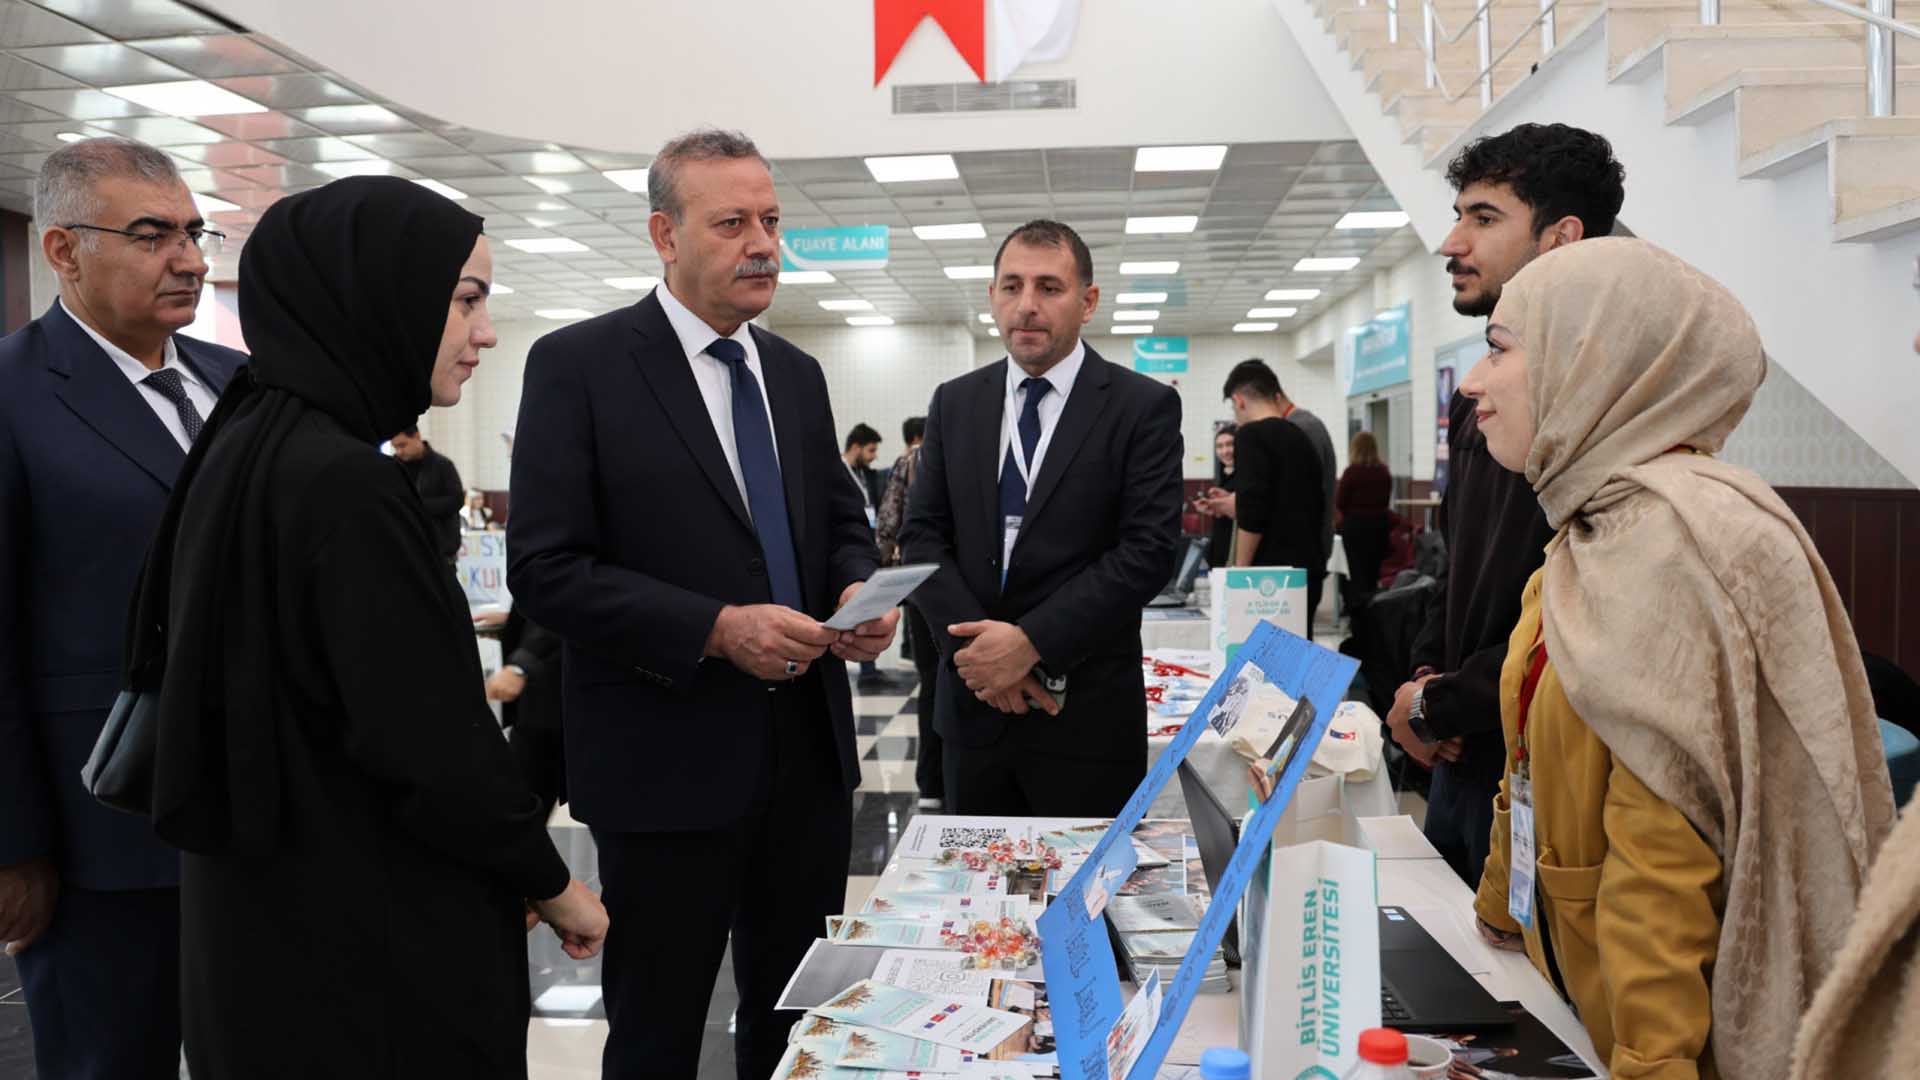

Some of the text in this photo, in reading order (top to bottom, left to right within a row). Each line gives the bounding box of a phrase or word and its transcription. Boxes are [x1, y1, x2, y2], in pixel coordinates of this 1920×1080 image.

[792, 235, 884, 252] FUAYE ALANI
[1296, 889, 1317, 1046] BİTLİS EREN
[1317, 877, 1341, 1057] ÜNİVERSİTESİ
